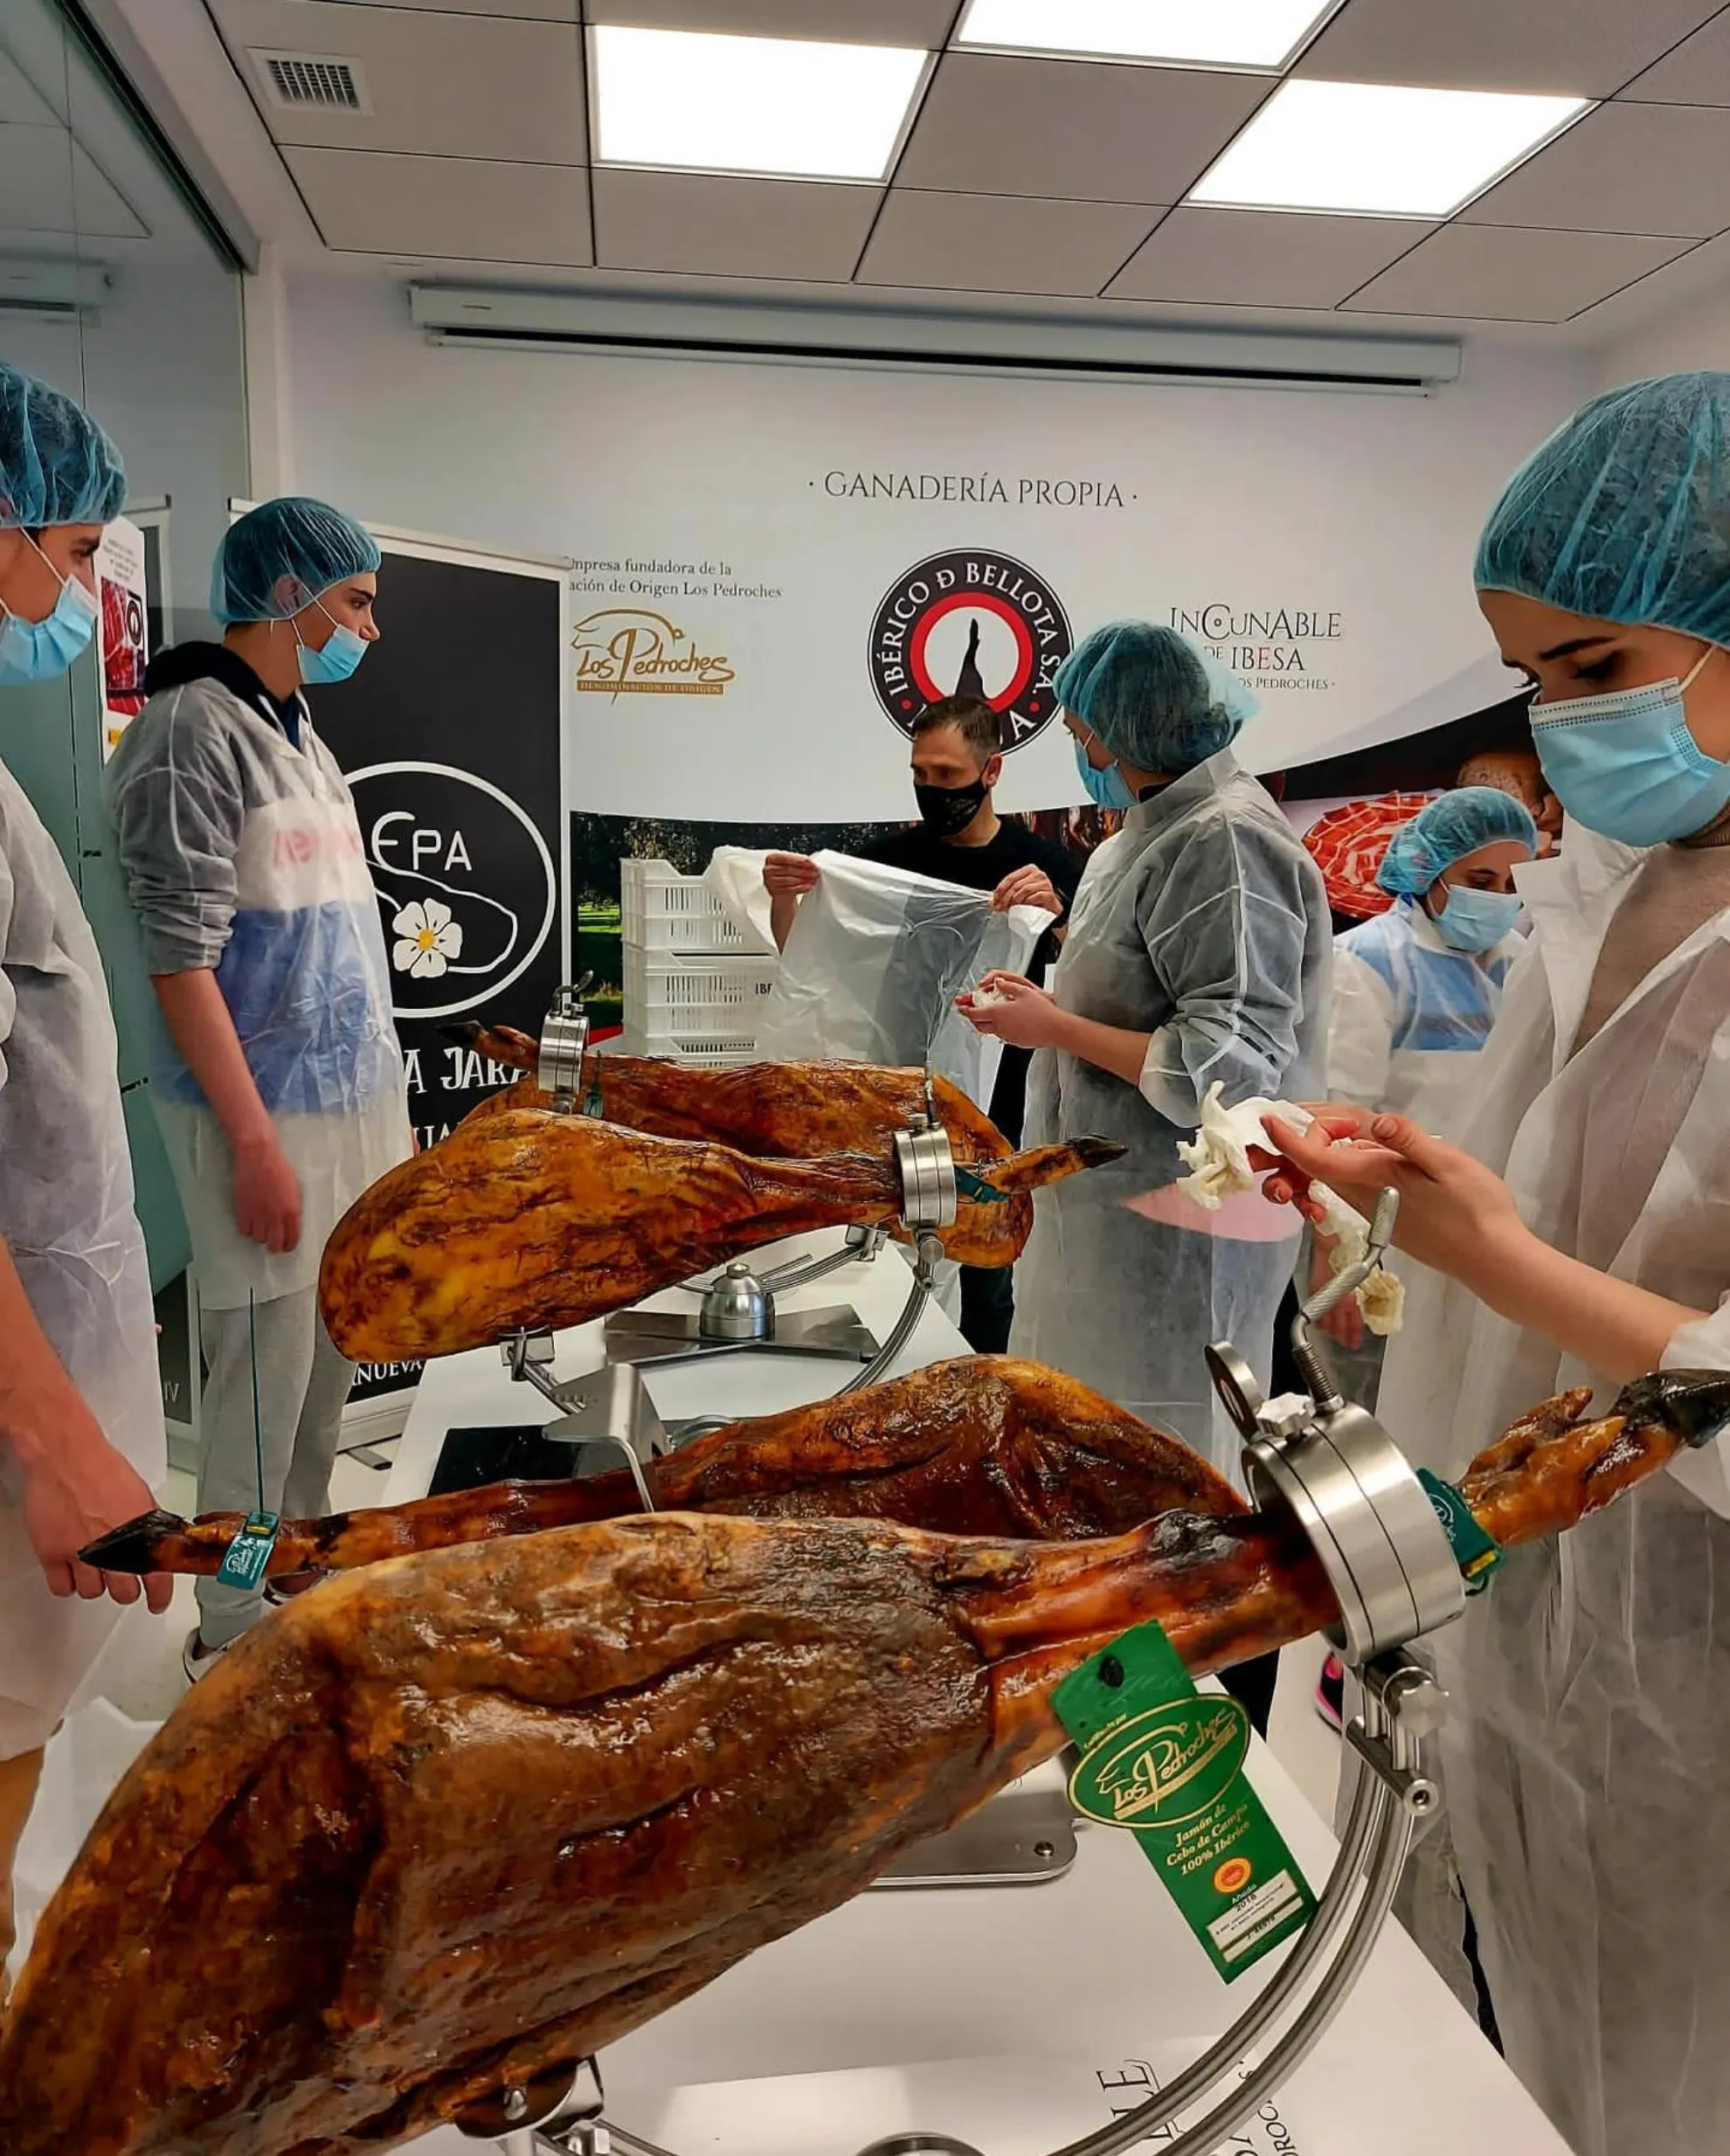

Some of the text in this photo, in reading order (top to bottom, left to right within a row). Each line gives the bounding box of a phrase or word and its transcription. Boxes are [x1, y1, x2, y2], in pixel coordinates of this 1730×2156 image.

[825, 471, 1124, 508] GANADERÍA PROPIA
[572, 557, 731, 576] mpresa fundadora de la
[570, 577, 782, 598] ación de Origen Los Pedroches
[876, 581, 930, 696] IBÉRICO
[966, 562, 1059, 646] BELLOTA
[576, 627, 735, 704] Los Pedroches
[1230, 646, 1305, 671] IBESA
[1256, 677, 1328, 690] PEDROCHES
[352, 1360, 423, 1386] NUEVA
[1115, 1781, 1148, 1810] Los
[1133, 1709, 1236, 1814] Pedroches
[1166, 1845, 1195, 1865] Cebo
[1197, 1835, 1211, 1848] de
[1181, 1849, 1214, 1876] 100%
